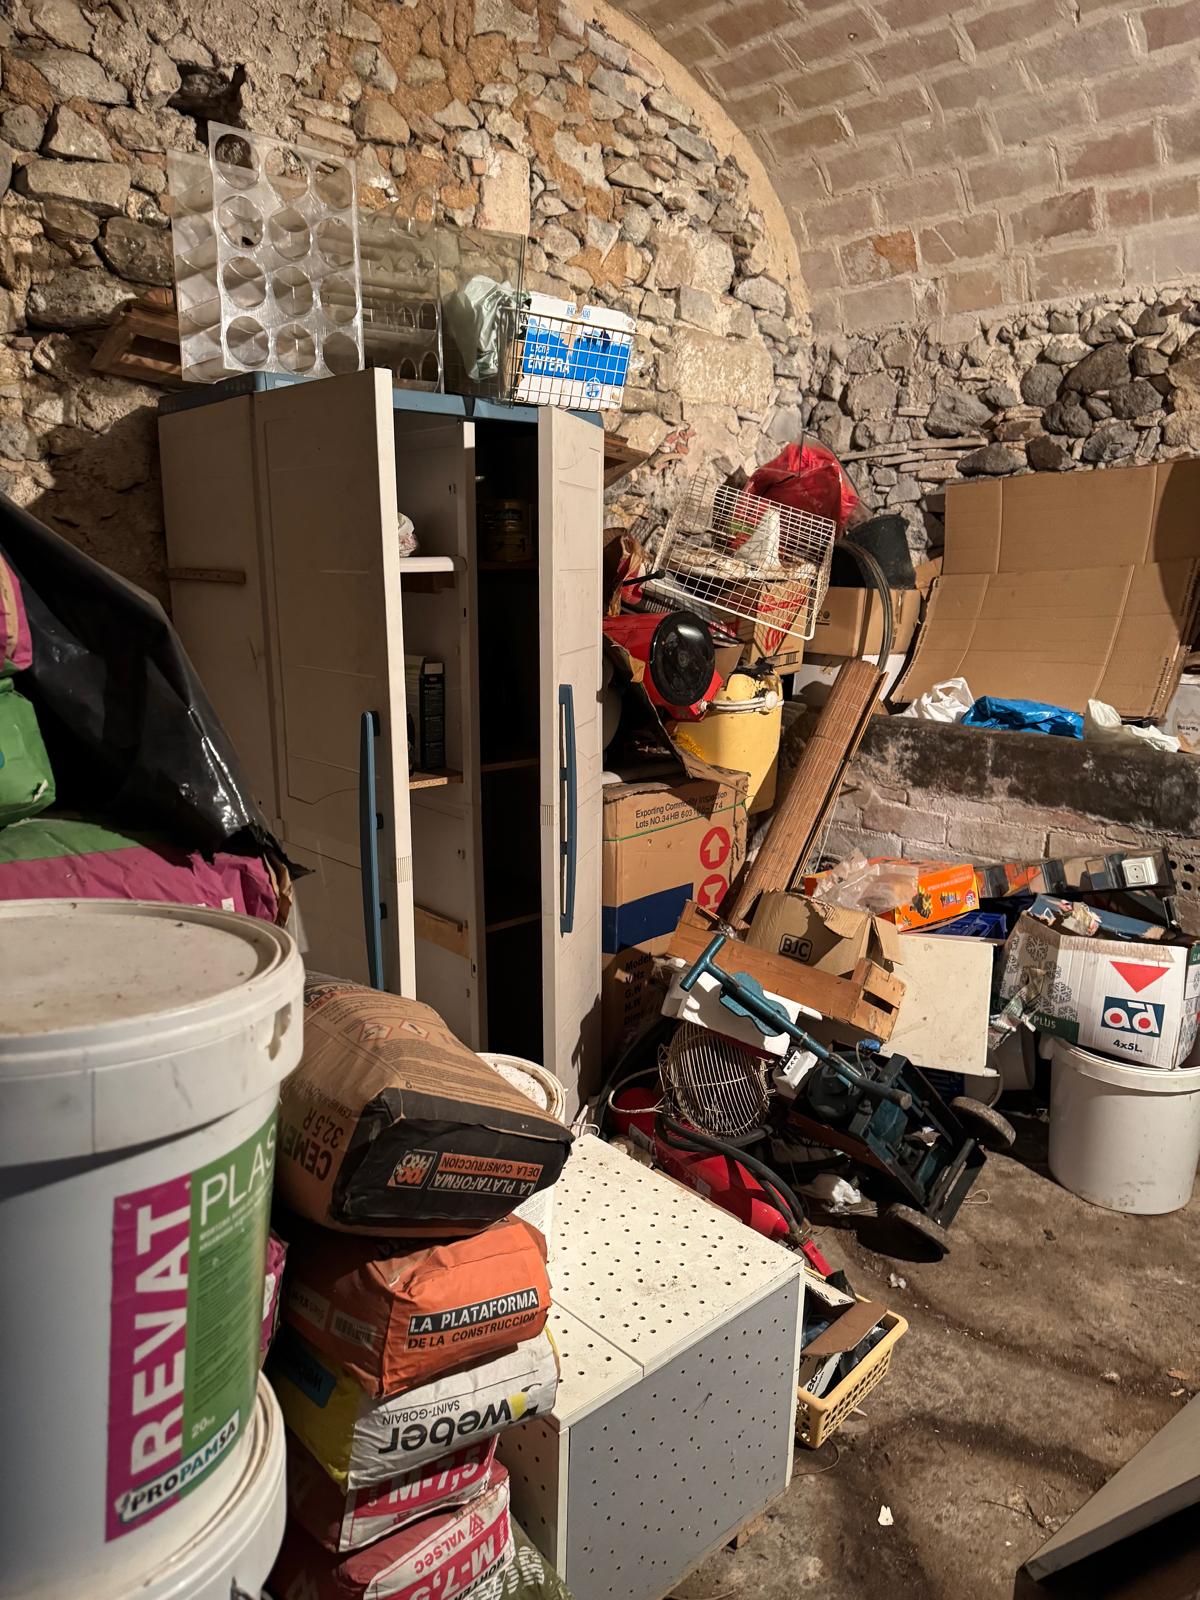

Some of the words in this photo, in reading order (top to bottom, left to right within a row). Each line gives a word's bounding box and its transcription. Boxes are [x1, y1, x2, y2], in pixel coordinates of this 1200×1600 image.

[527, 353, 570, 375] ENTERA
[635, 804, 664, 819] Exporting
[635, 820, 649, 829] Lots
[781, 937, 810, 957] BJC
[625, 952, 651, 971] Model
[1033, 1015, 1057, 1029] PLUS
[302, 1107, 318, 1131] R
[311, 1115, 343, 1149] 32,5
[440, 1157, 513, 1175] CONSTRUCCION
[516, 1166, 528, 1177] LA
[527, 1168, 541, 1178] DE
[434, 1172, 515, 1194] PLATAFORMA
[519, 1182, 536, 1196] LA
[409, 1317, 433, 1334] LA
[440, 1291, 538, 1329] PLATAFORMA
[408, 1337, 426, 1350] DE
[429, 1335, 445, 1348] LA
[452, 1312, 539, 1343] CONSTRUCCION
[382, 1400, 460, 1426] SAINT-GOBAIN
[378, 1398, 513, 1455] weber
[131, 1420, 237, 1512] PROPAMSA
[388, 1450, 481, 1505] M-7,5
